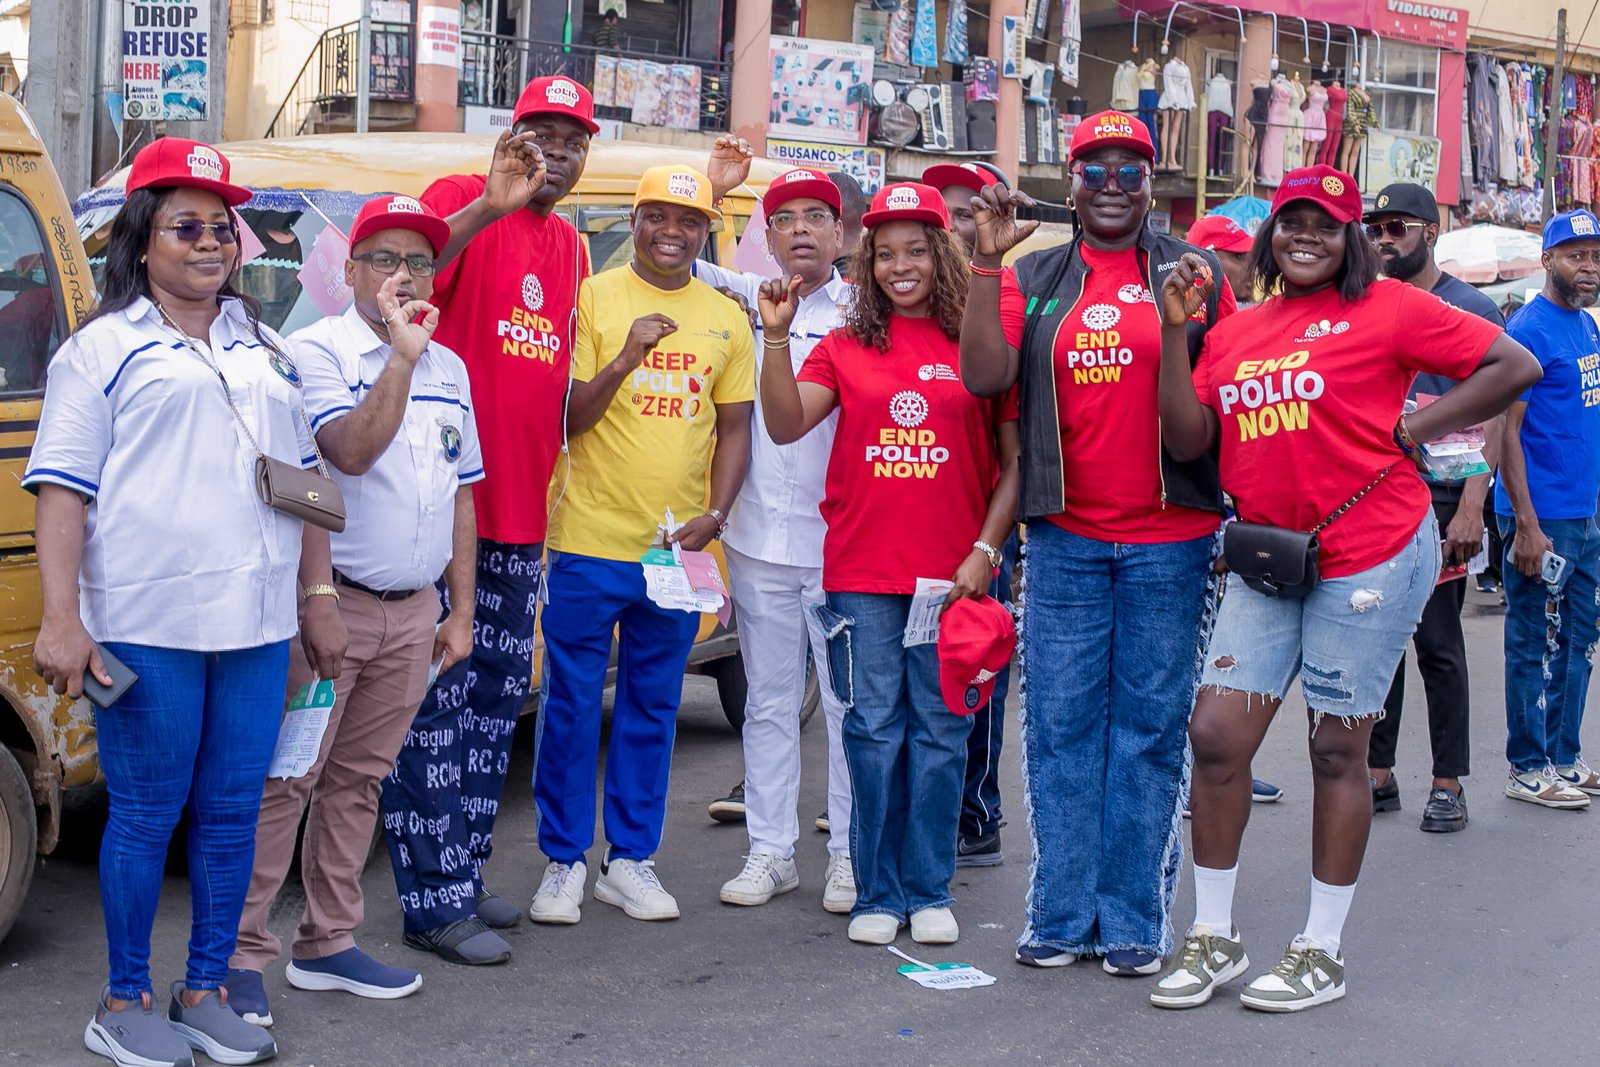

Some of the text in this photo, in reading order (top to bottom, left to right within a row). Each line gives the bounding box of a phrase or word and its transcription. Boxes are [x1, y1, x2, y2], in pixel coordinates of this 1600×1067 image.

[134, 6, 198, 27] DROP
[1387, 0, 1458, 23] VIDALOKA
[123, 31, 208, 57] REFUSE
[124, 63, 161, 80] HERE
[548, 87, 578, 100] POLIO
[1100, 115, 1130, 125] END
[1094, 124, 1134, 135] POLIO
[780, 146, 836, 162] BUSANCO
[189, 156, 223, 173] POLIO
[672, 174, 695, 182] KEEP
[1287, 176, 1320, 188] Rotary
[888, 195, 919, 205] POLIO
[511, 306, 553, 333] END
[497, 319, 560, 352] POLIO
[1076, 330, 1120, 349] END
[502, 338, 554, 365] NOW
[1067, 347, 1133, 368] POLIO
[1234, 350, 1310, 381] END
[1577, 353, 1600, 373] KEEP
[1073, 366, 1121, 384] NOW
[1218, 370, 1325, 415] POLIO
[1236, 401, 1309, 442] NOW
[879, 428, 936, 446] END
[865, 445, 950, 463] POLIO
[874, 461, 939, 479] NOW
[468, 748, 493, 774] RC
